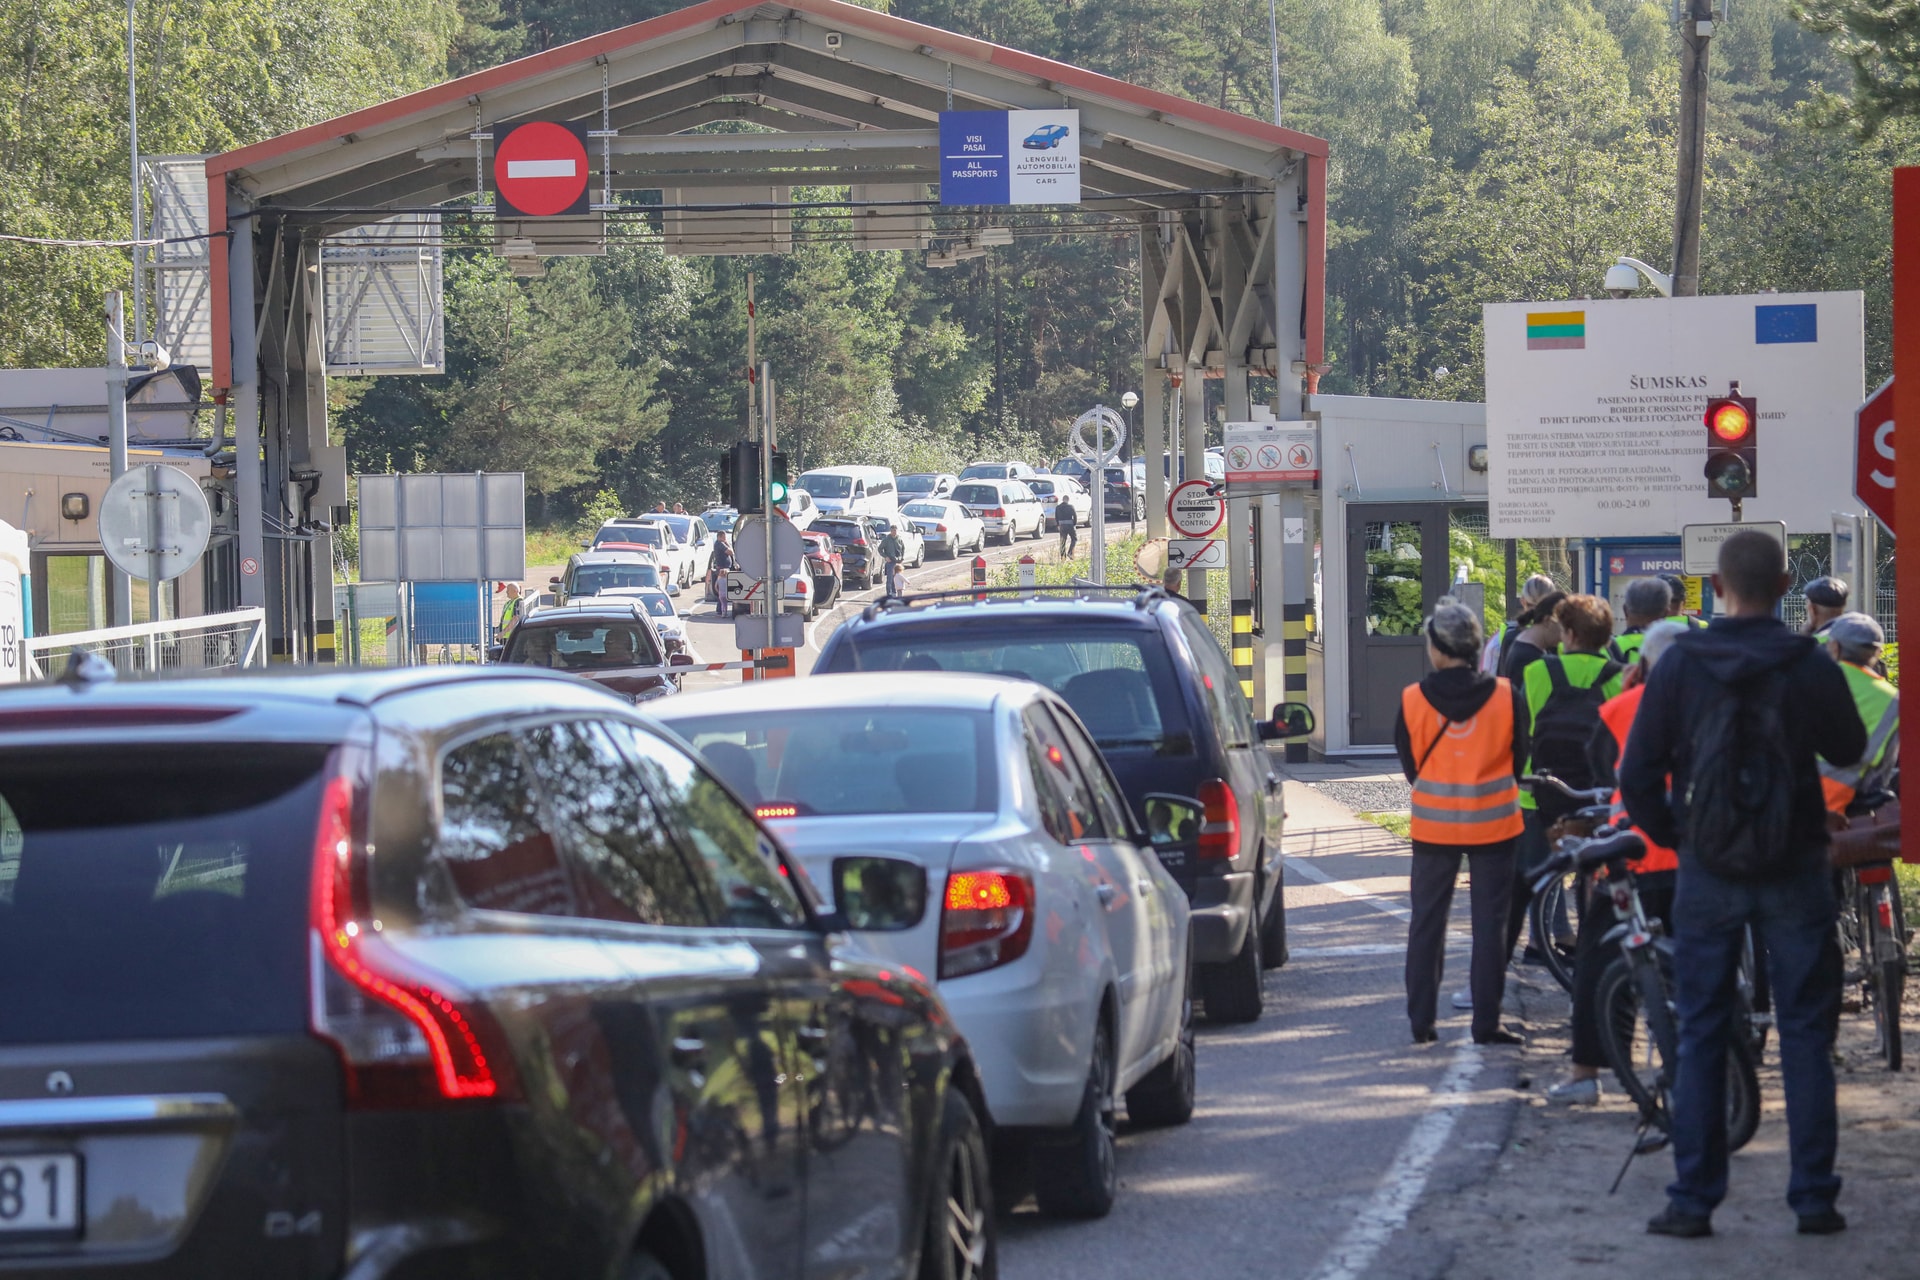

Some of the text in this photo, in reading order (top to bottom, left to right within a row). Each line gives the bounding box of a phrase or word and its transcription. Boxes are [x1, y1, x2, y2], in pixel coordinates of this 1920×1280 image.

[952, 170, 998, 178] PASSPORTS
[1630, 375, 1707, 389] ŠUMSKAS
[1597, 396, 1637, 404] PASIENIO
[1610, 406, 1646, 414] BORDER
[1647, 405, 1692, 413] CROSSING
[1651, 414, 1704, 422] ГОСУДАРСТ
[1549, 441, 1577, 449] UNDER
[1578, 440, 1602, 448] VIDEO
[1508, 468, 1544, 476] FILMUOTI
[1559, 476, 1625, 484] PHOTOGRAPHING
[1634, 475, 1681, 483] PROHIBITED
[1641, 560, 1683, 571] INFOR
